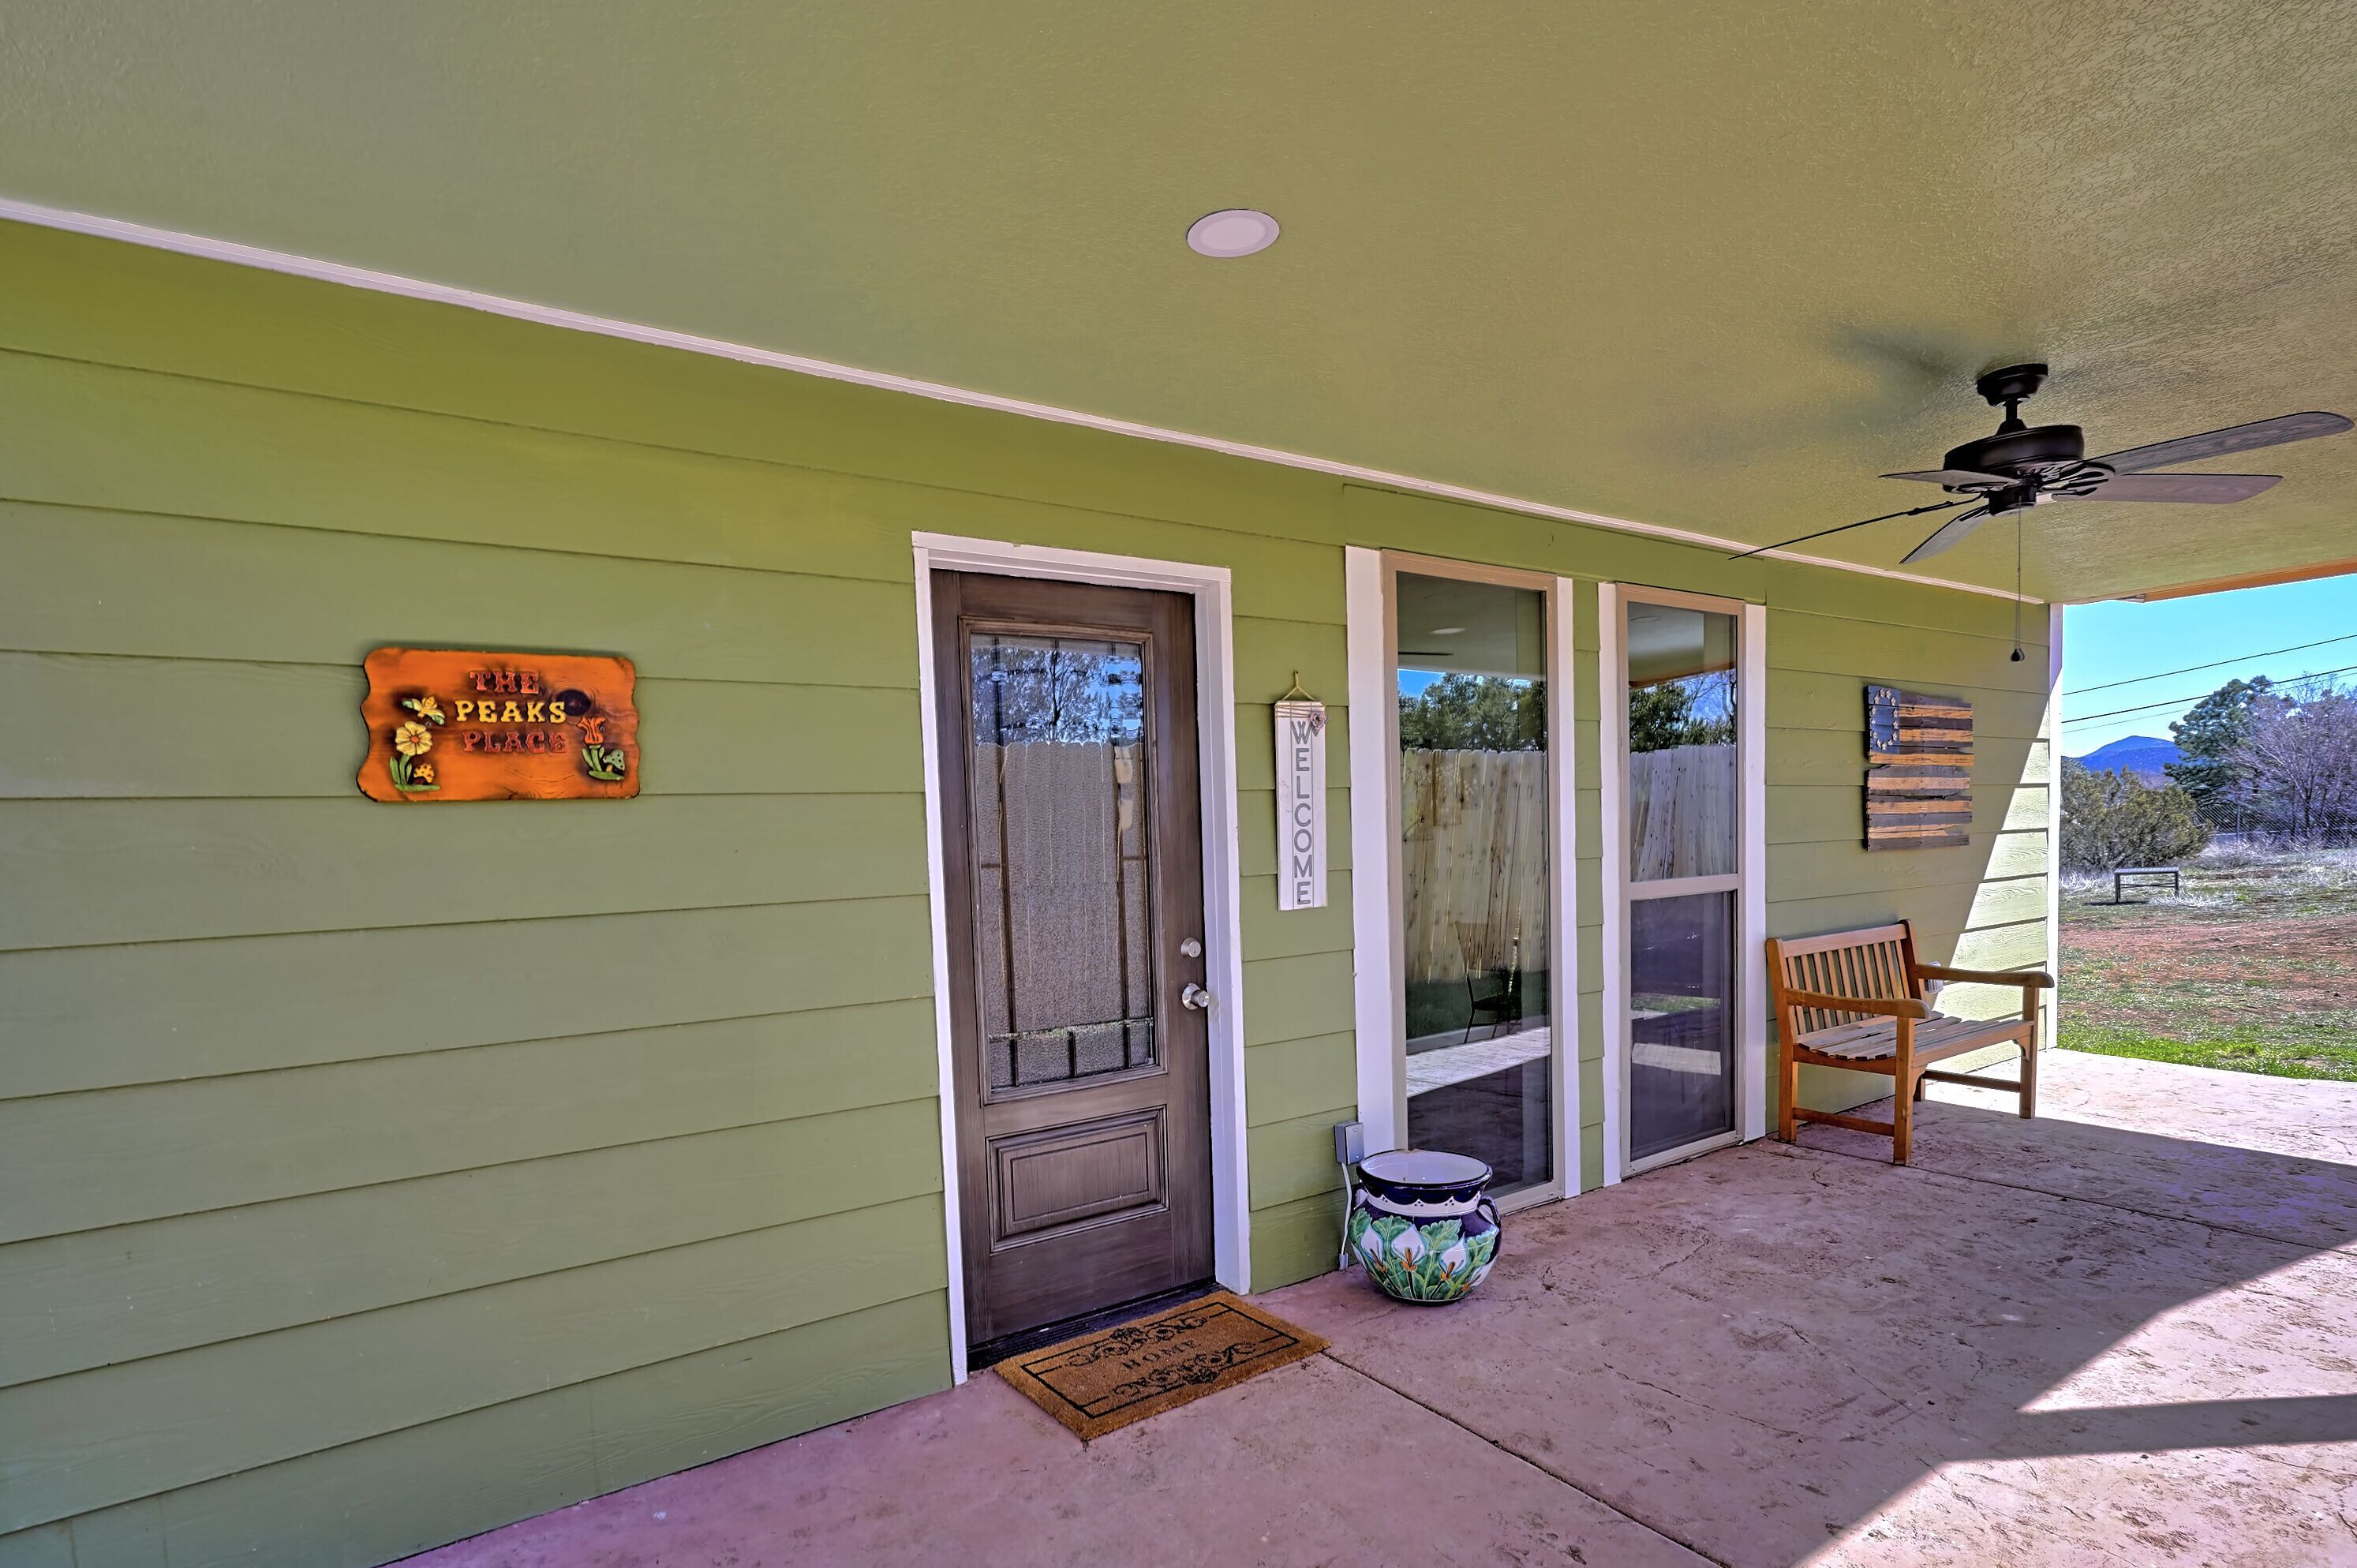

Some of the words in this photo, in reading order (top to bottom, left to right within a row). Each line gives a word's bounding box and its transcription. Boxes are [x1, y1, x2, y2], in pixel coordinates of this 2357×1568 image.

[470, 671, 539, 694] THE
[455, 700, 567, 724] PEAKS
[462, 731, 567, 754] PLACE
[1291, 720, 1312, 905] WELCOME
